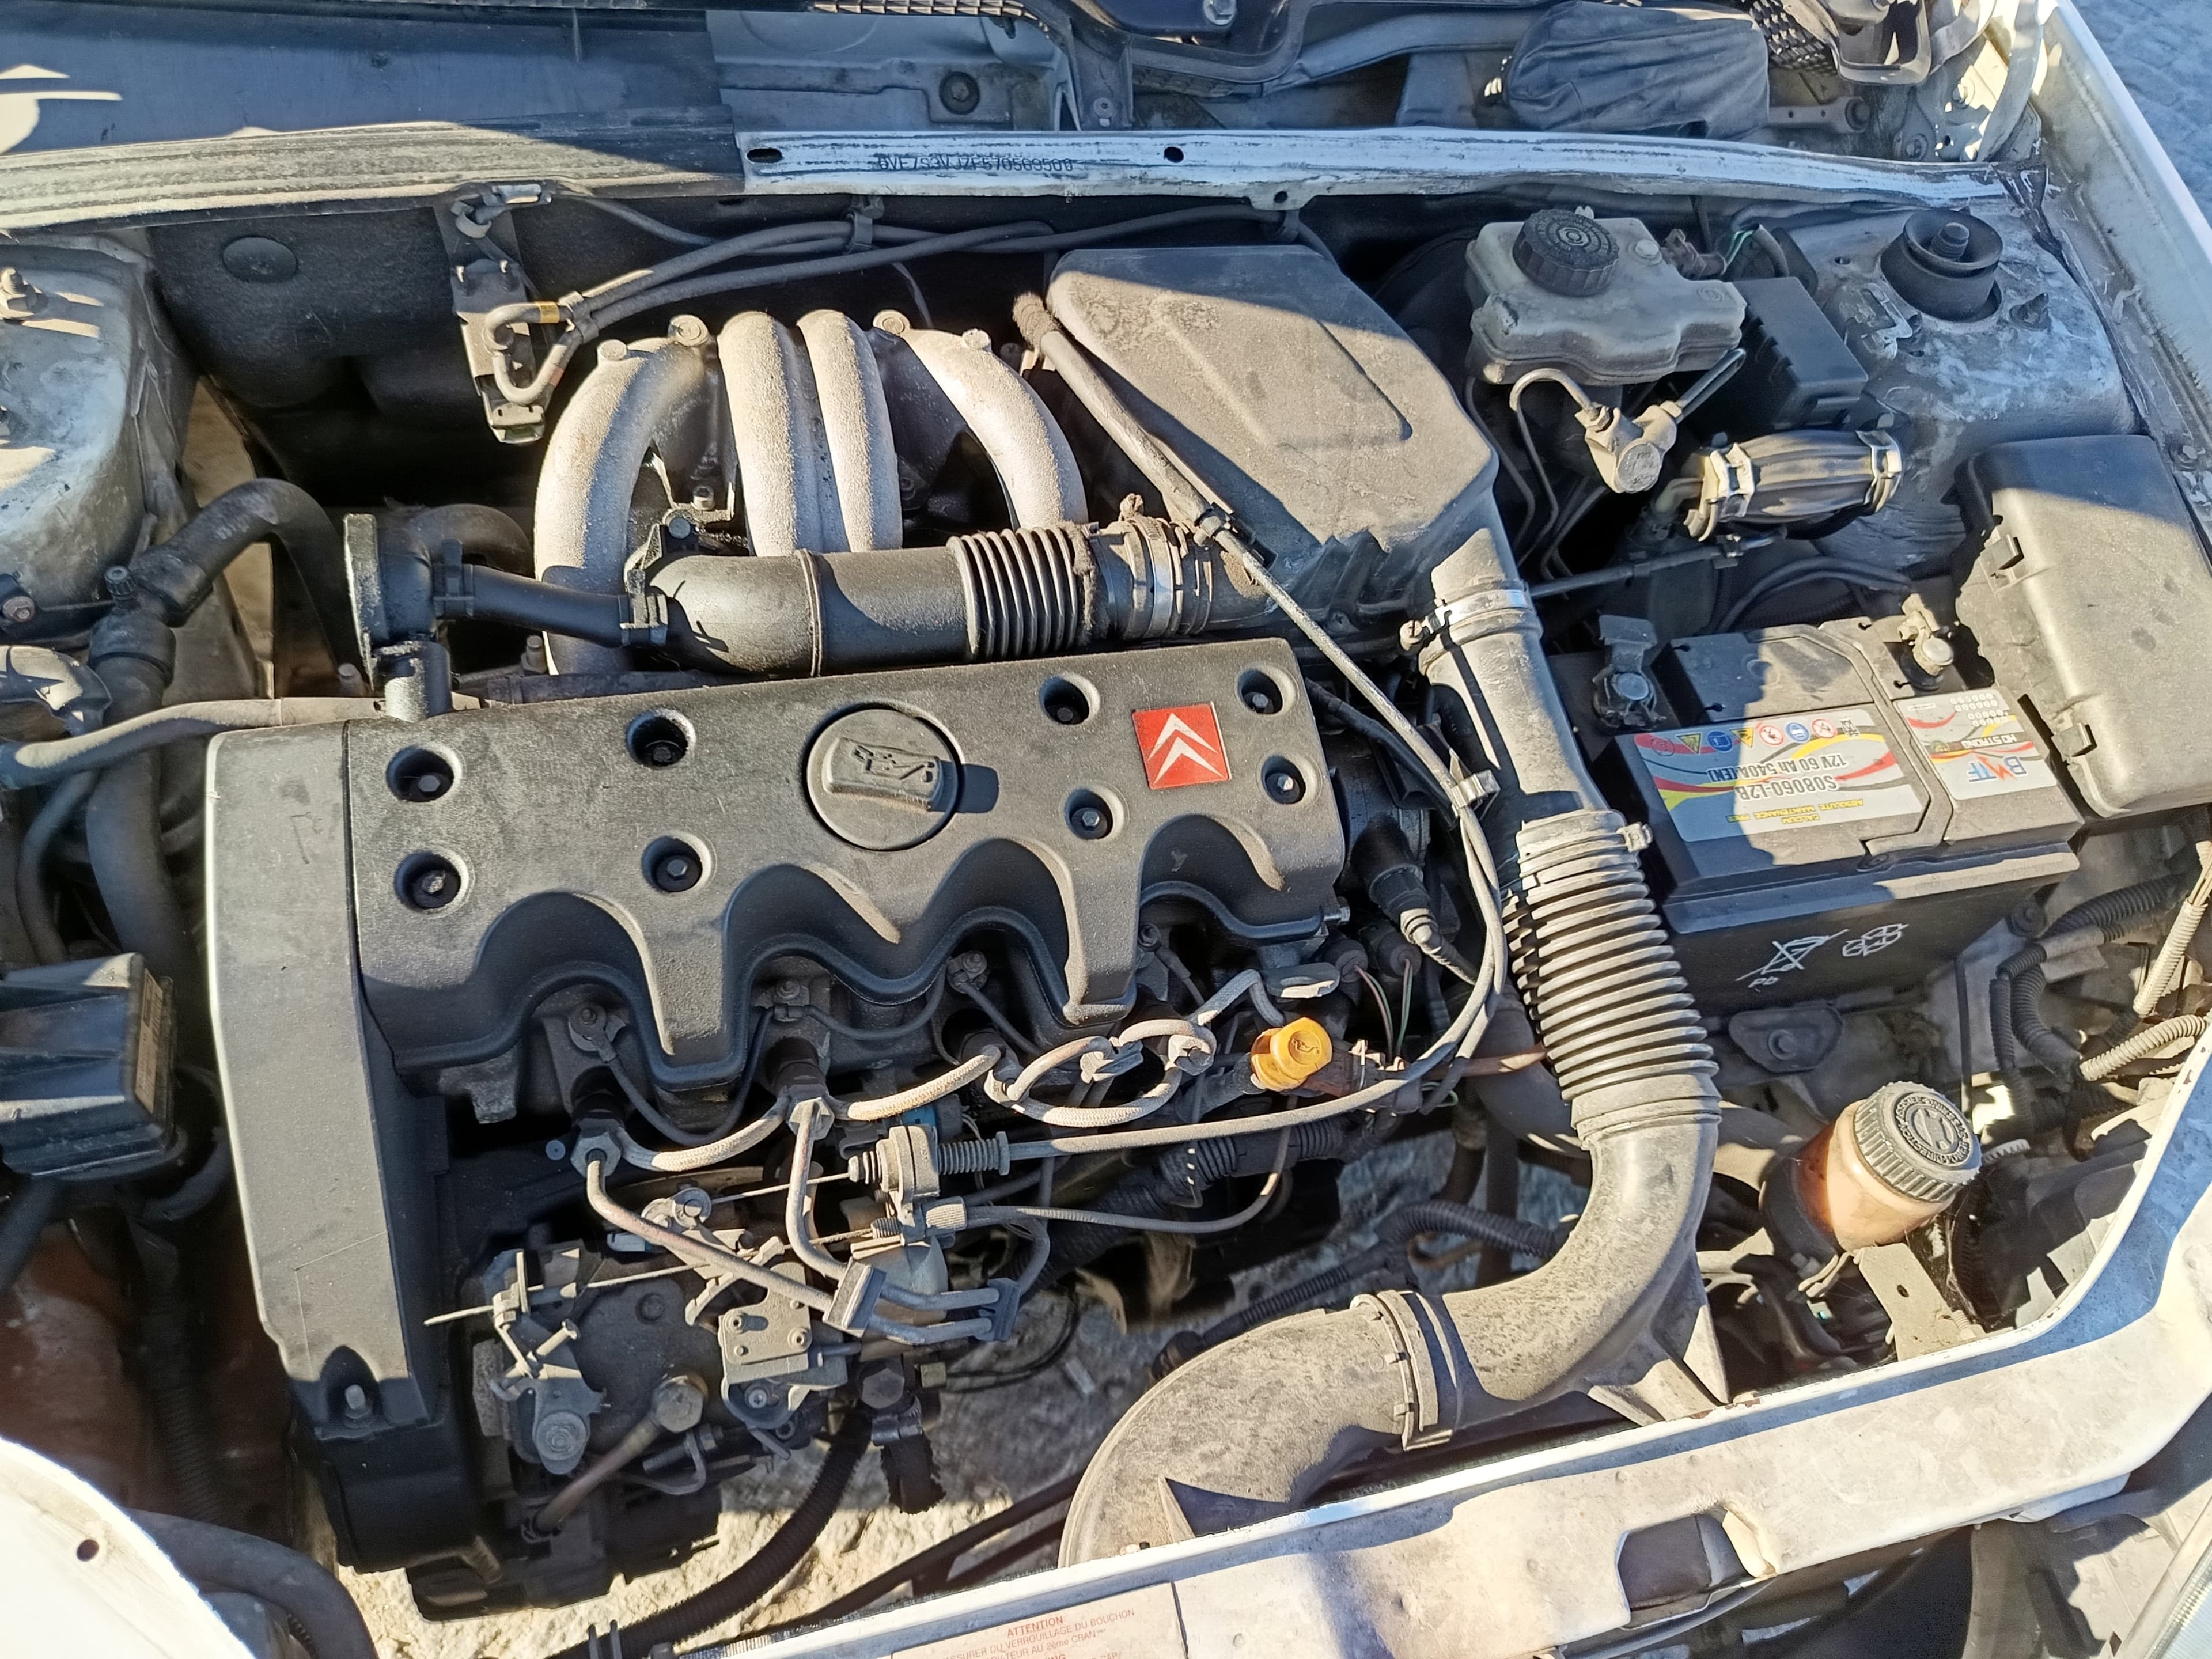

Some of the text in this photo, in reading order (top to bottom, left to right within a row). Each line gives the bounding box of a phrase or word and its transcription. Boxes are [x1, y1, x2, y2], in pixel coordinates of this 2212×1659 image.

[1779, 758, 1798, 774] Ah
[1800, 758, 1820, 771] 60
[1821, 755, 1846, 769] 12V
[1755, 806, 1816, 819] MAINTENANCE
[1819, 799, 1863, 812] ABSOLUTE
[1006, 1626, 1073, 1649] VERROUILLAGE
[1075, 1622, 1088, 1631] DU
[1090, 1608, 1134, 1626] BOUCHON
[1007, 1615, 1064, 1638] ATTENTION
[1032, 1643, 1043, 1654] AU
[1071, 1630, 1096, 1643] CRAN
